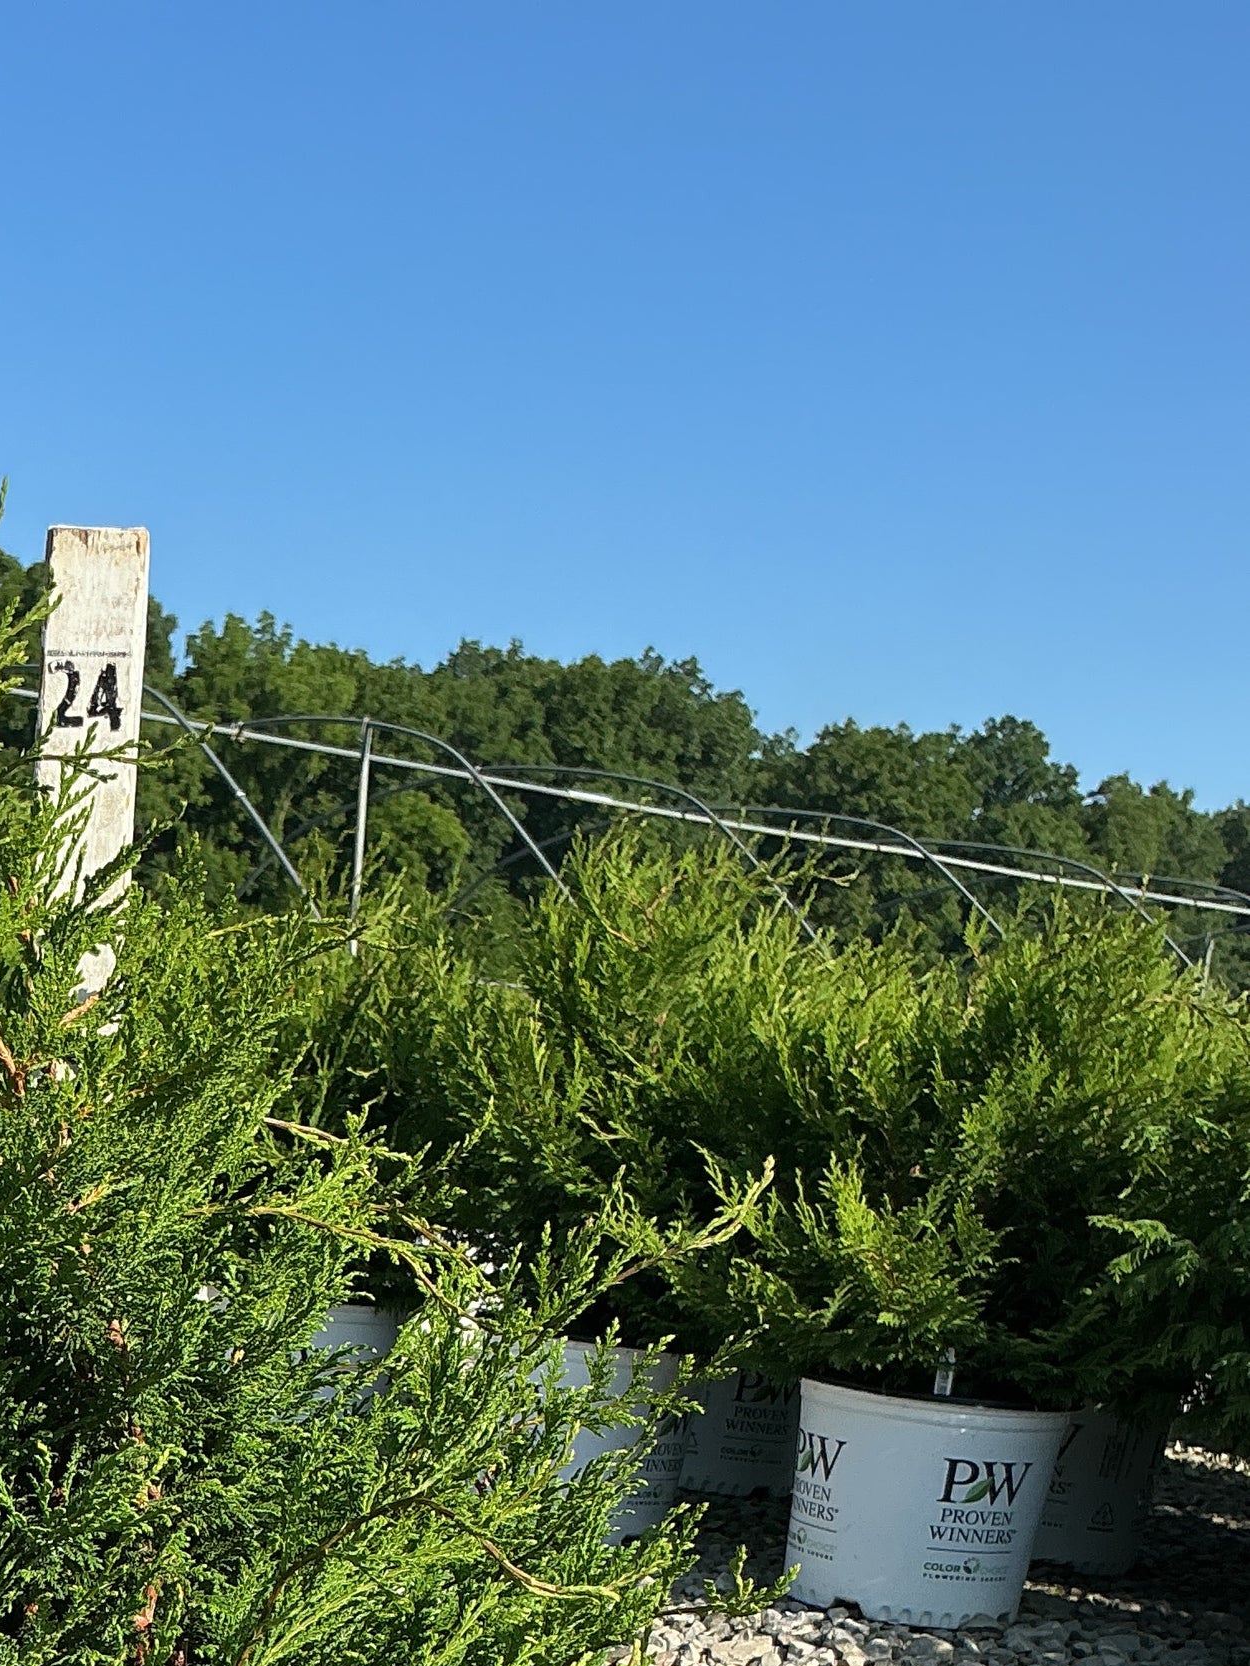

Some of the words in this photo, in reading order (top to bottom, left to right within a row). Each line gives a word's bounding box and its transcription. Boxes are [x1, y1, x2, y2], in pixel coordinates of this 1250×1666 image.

[48, 660, 124, 732] 24
[734, 1406, 790, 1420] PROVEN
[725, 1418, 791, 1435] WINNERS
[795, 1478, 832, 1502] OVEN
[936, 1458, 1033, 1507] PW
[793, 1496, 835, 1521] NNERS
[940, 1507, 1013, 1526] PROVEN
[923, 1562, 961, 1572] COLOR
